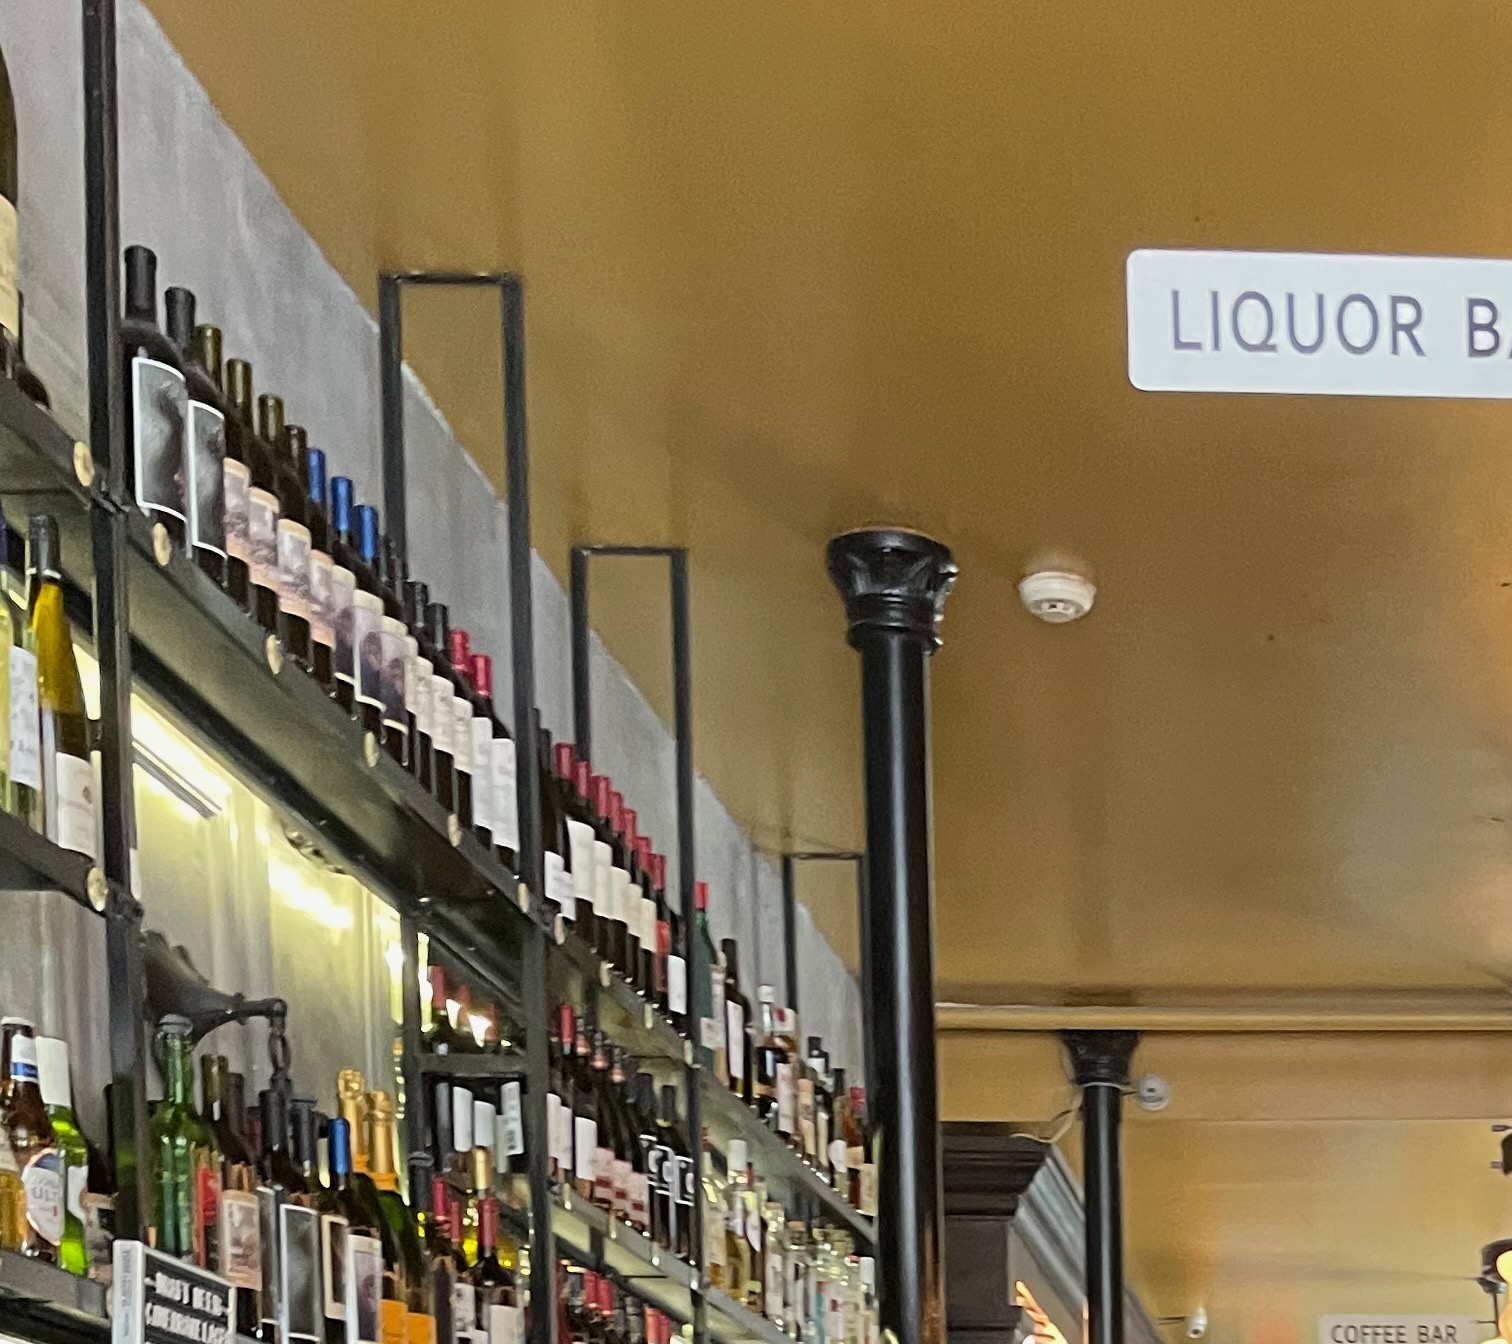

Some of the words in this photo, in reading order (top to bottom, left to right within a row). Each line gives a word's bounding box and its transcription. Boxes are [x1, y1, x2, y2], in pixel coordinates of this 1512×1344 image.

[1171, 289, 1426, 357] LIQUOR
[1331, 1325, 1407, 1344] COFFEE
[1417, 1325, 1458, 1344] BAR
